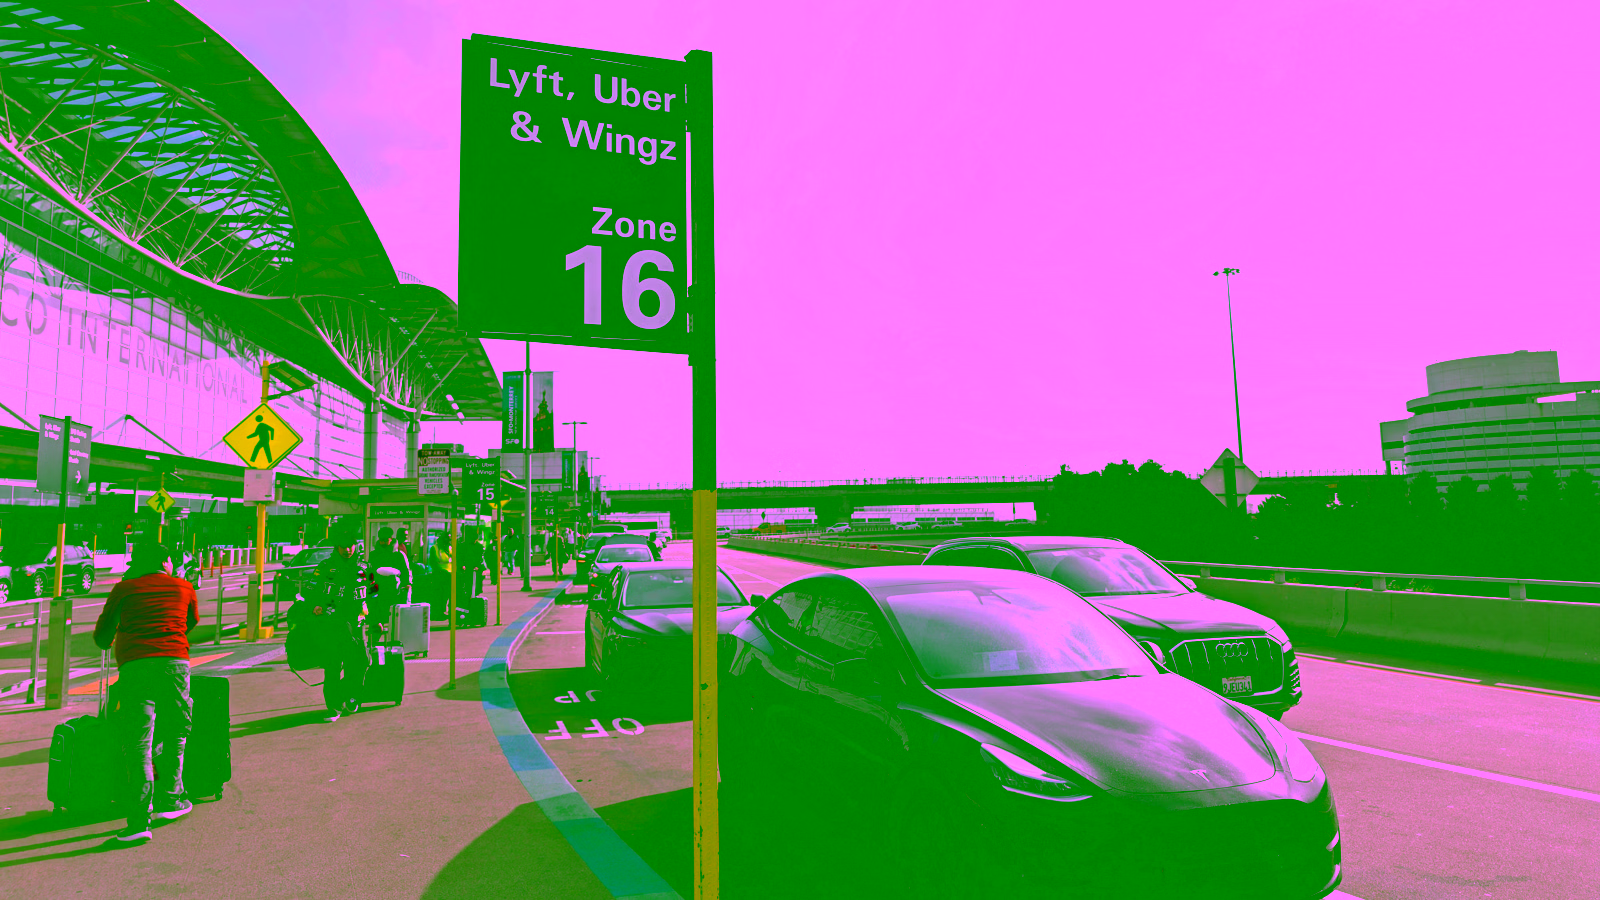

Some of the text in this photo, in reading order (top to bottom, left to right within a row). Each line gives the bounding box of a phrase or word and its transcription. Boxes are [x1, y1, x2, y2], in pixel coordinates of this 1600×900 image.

[490, 57, 676, 112] Lyft, Uber
[510, 110, 677, 165] & Wingz
[592, 206, 677, 242] Zone
[565, 244, 676, 329] 16
[66, 307, 248, 404] INTERNATIONAL
[418, 457, 428, 466] NO
[477, 487, 495, 501] 15
[1223, 680, 1252, 693] 9JEU341
[544, 717, 645, 741] OFF
